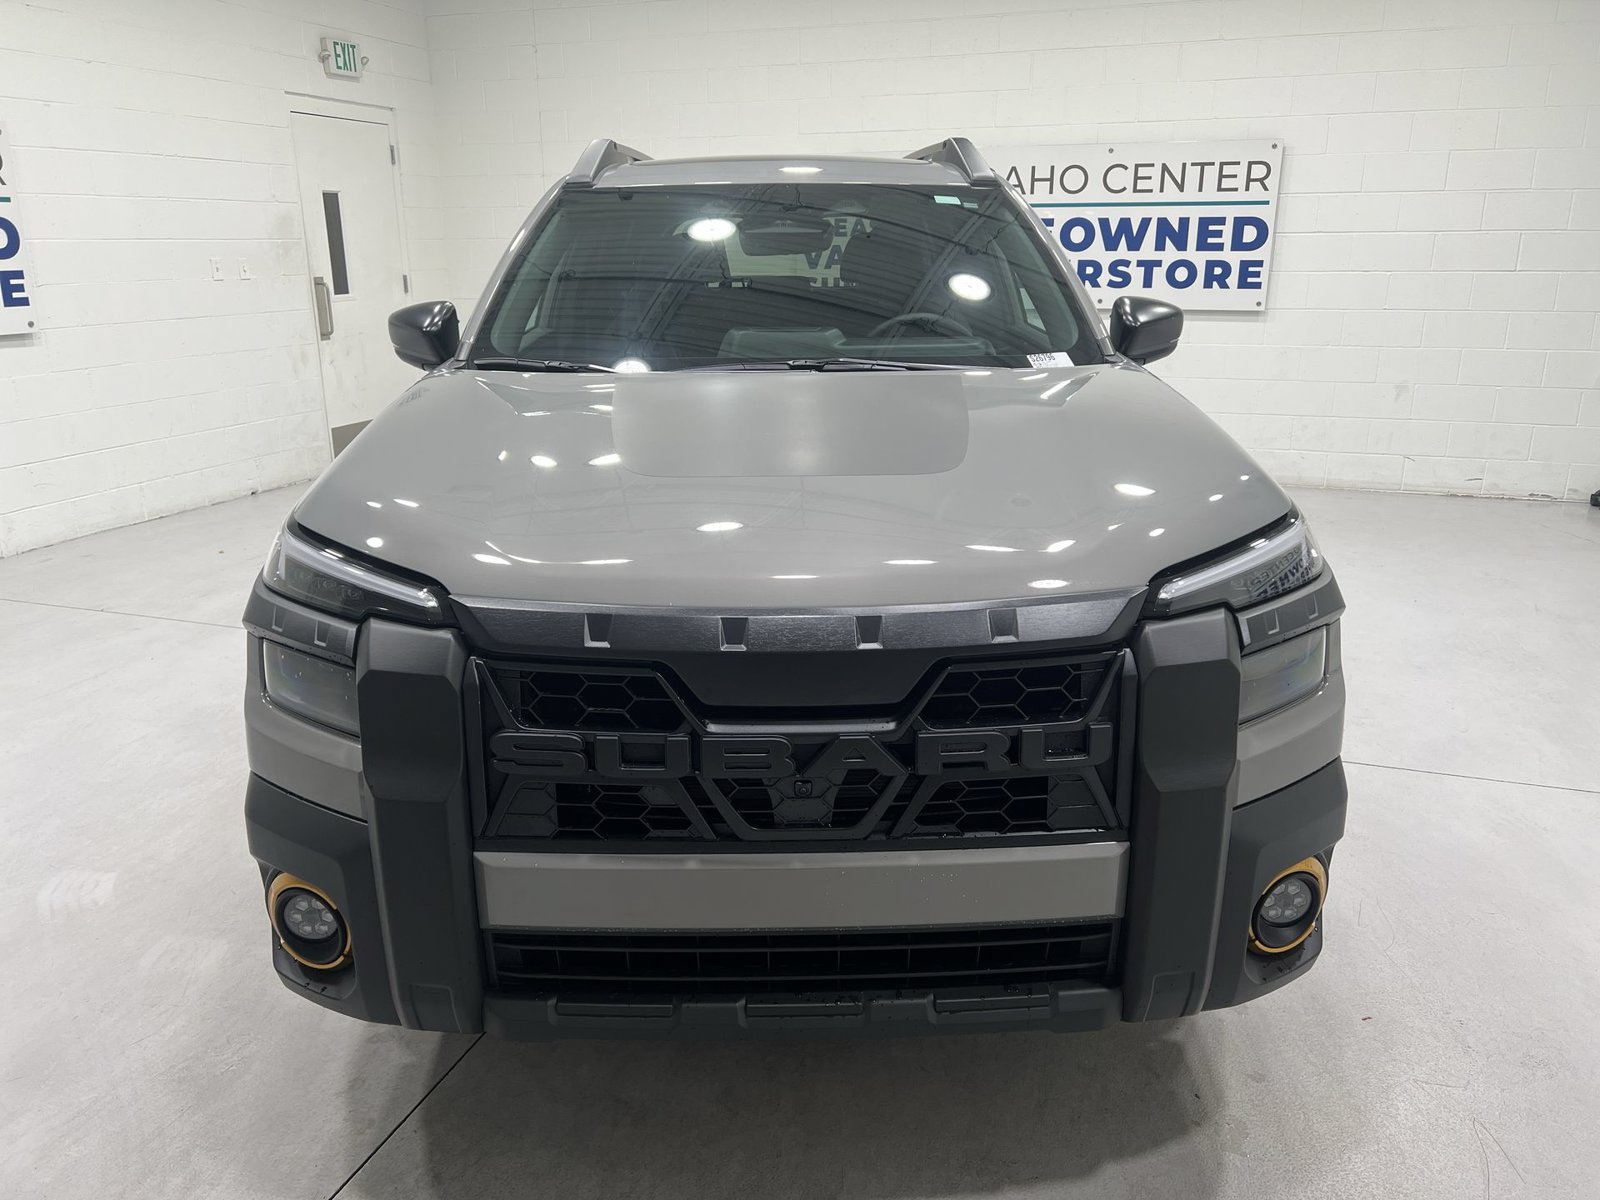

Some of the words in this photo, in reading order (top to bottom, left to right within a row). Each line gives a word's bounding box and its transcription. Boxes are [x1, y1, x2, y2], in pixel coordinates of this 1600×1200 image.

[332, 41, 357, 72] EXIT
[1102, 160, 1272, 194] CENTER
[1040, 216, 1270, 252] OWNED
[1076, 259, 1264, 290] RSTORE
[488, 722, 1113, 776] SUBARU
